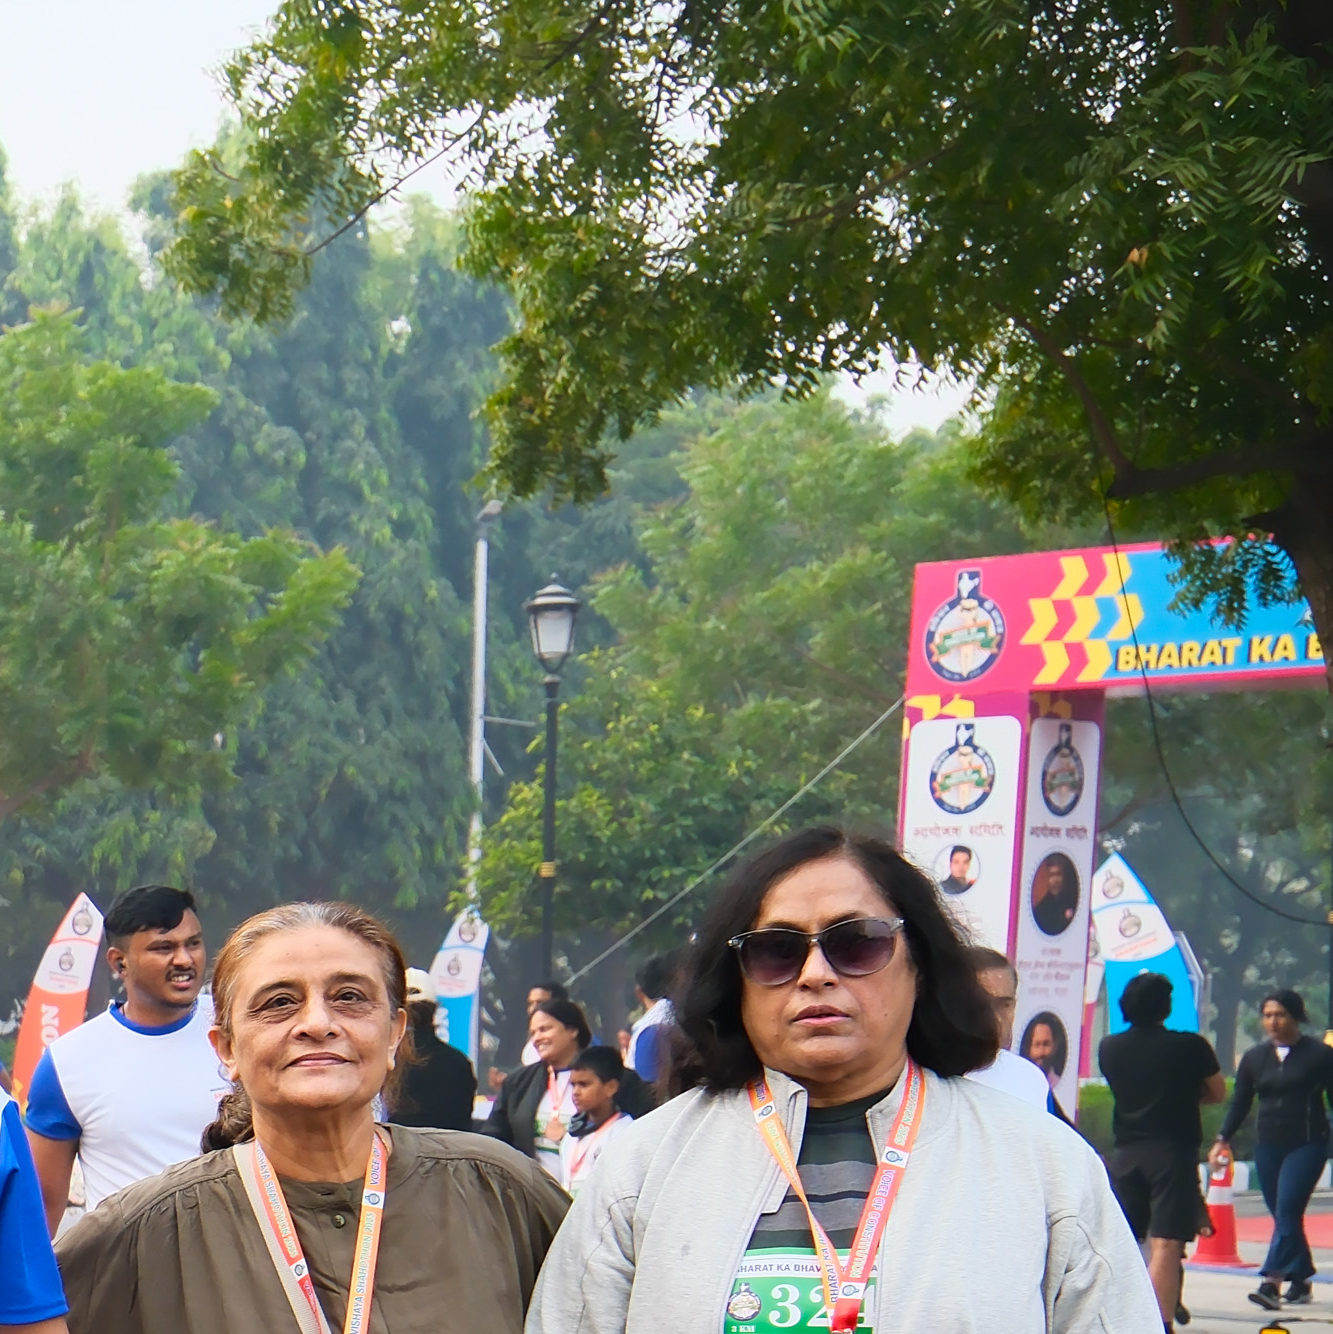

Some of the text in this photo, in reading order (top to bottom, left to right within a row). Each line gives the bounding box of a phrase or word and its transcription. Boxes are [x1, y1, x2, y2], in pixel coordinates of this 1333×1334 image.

[1116, 637, 1243, 672] BHARAT
[1248, 633, 1297, 663] KA
[369, 1157, 381, 1185] VOICE
[849, 1169, 896, 1278] VOICE OF CONSTITUTION
[776, 1263, 791, 1272] KA
[739, 1325, 756, 1333] KM
